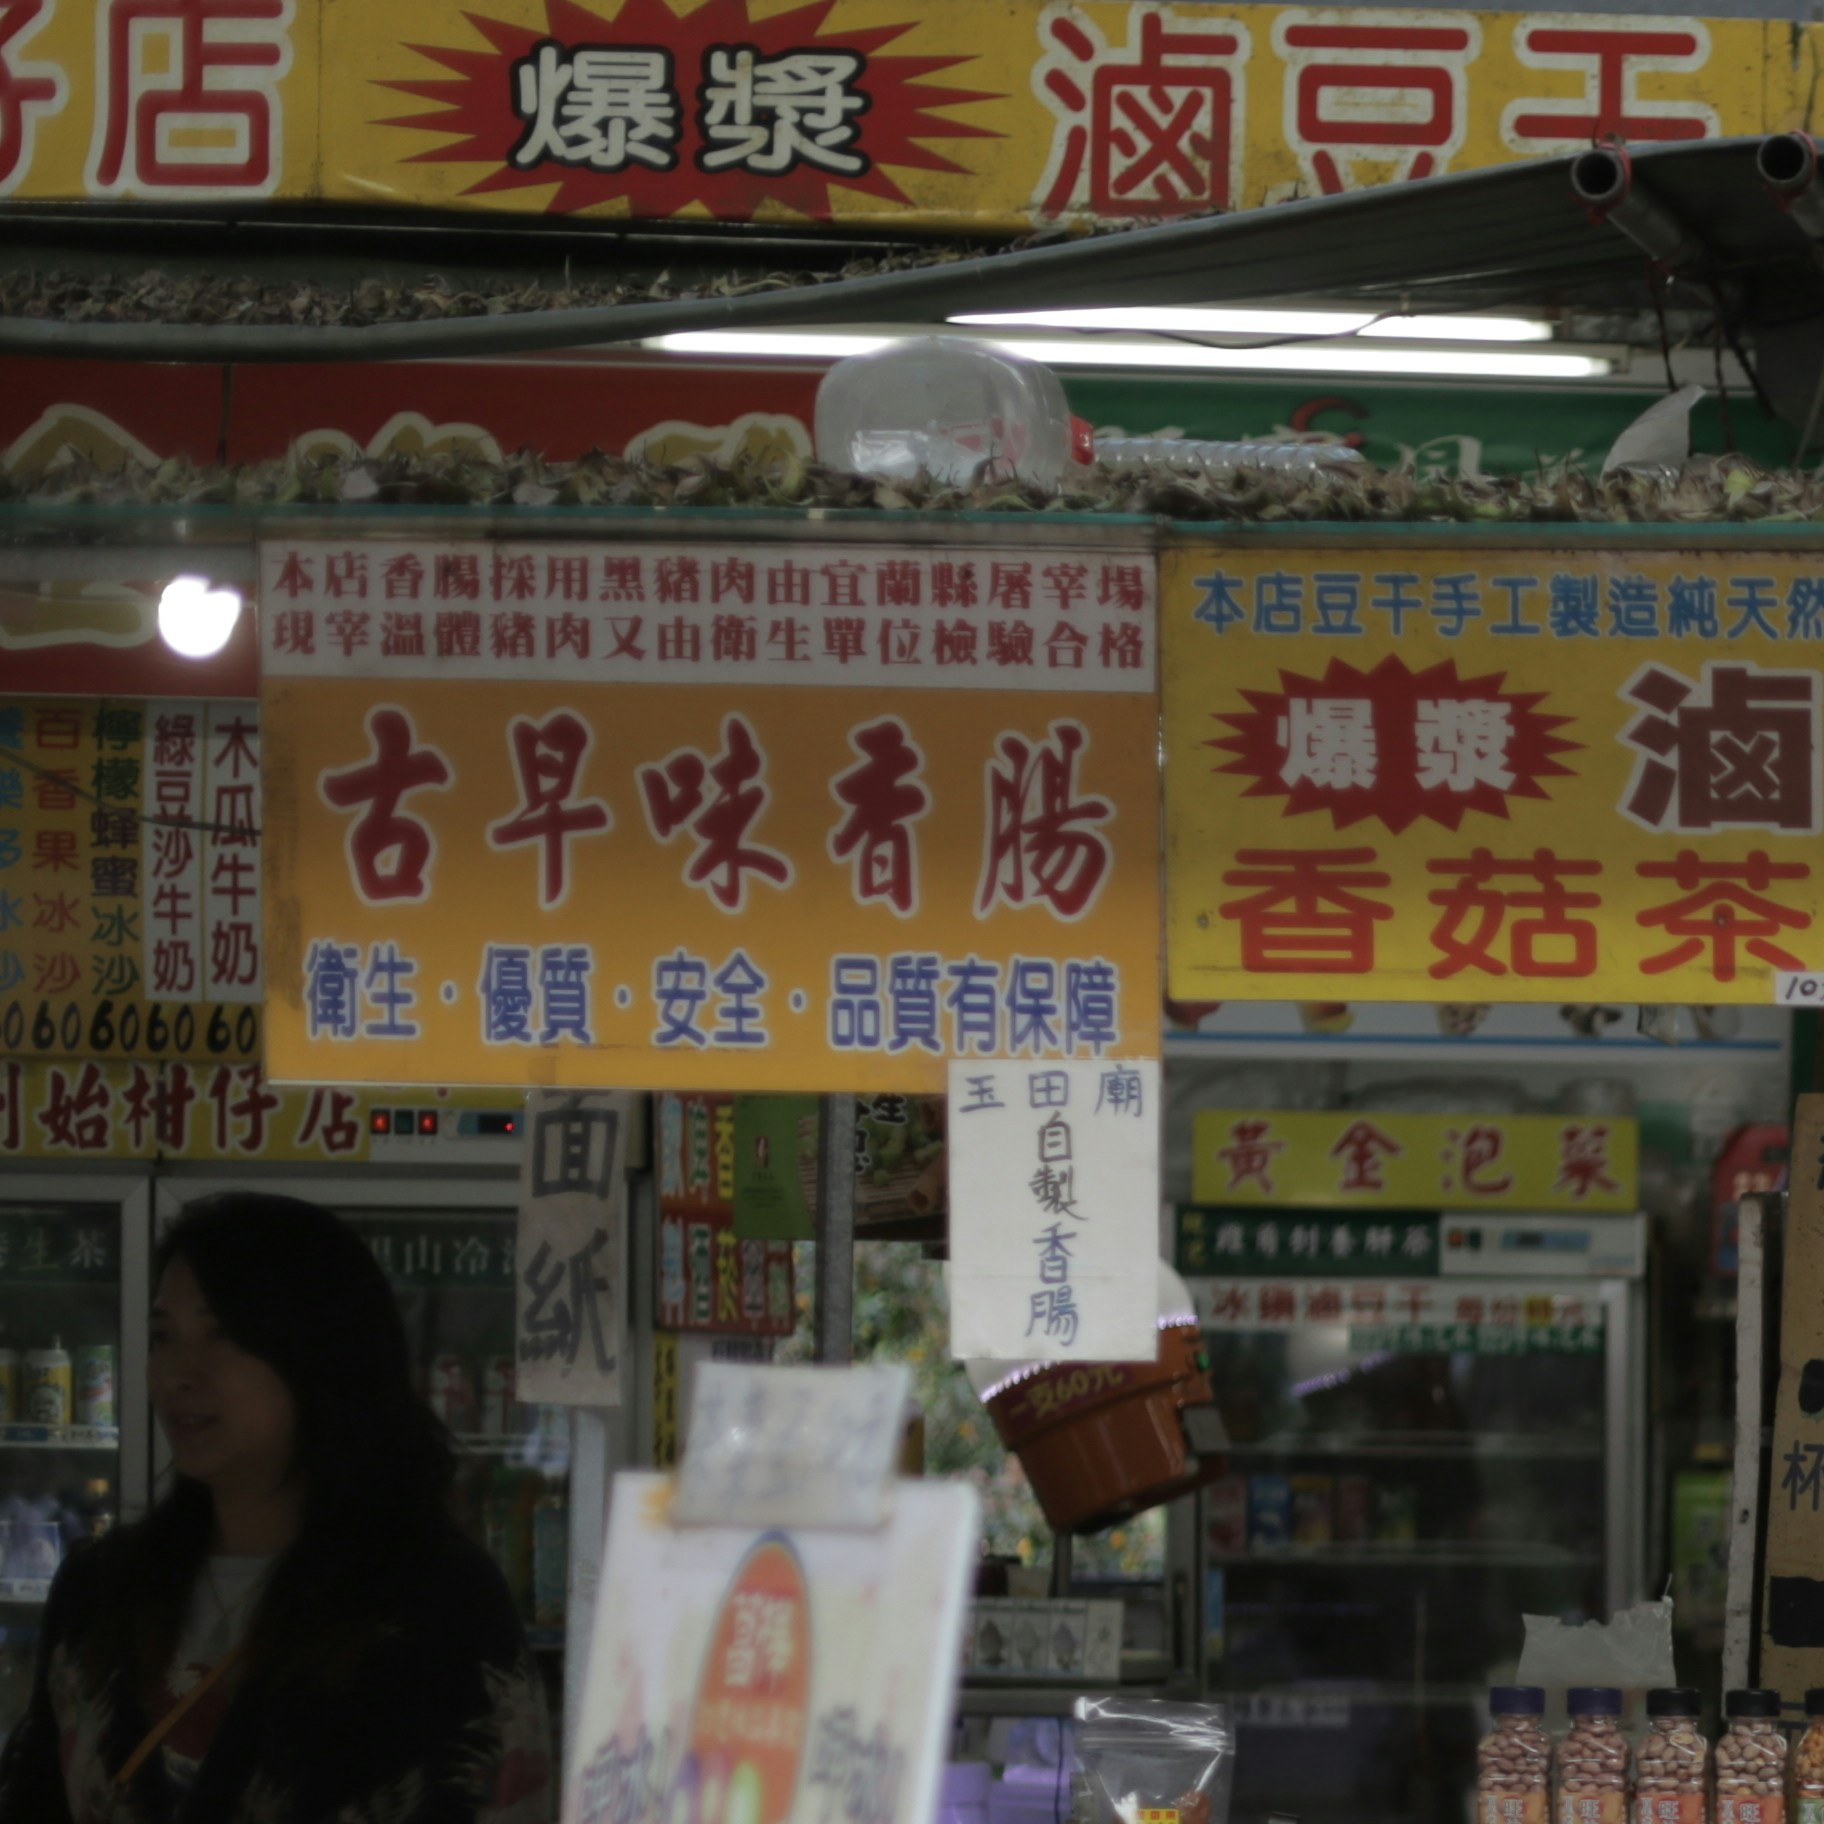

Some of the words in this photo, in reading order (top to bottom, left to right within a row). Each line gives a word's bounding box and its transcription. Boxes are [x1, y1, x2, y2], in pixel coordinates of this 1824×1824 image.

[512, 44, 872, 177] 爆漿
[271, 550, 1146, 612] 本店香腸採用黑豬肉由宜蘭縣屠宰場
[271, 609, 1146, 672] 現宰溫體豬肉又由衛生單位檢驗合格
[1275, 697, 1517, 796] 爆漿
[32, 708, 82, 995] 百香果冰沙
[211, 715, 260, 986] 木瓜牛奶
[320, 704, 1113, 921] 古早味香腸
[31, 999, 82, 1052] 60
[89, 999, 140, 1053] 60
[146, 1001, 196, 1053] 60
[206, 1003, 258, 1055] 60
[1217, 1119, 1622, 1199] 黃金泡菜
[1026, 1111, 1090, 1348] 自製香腸
